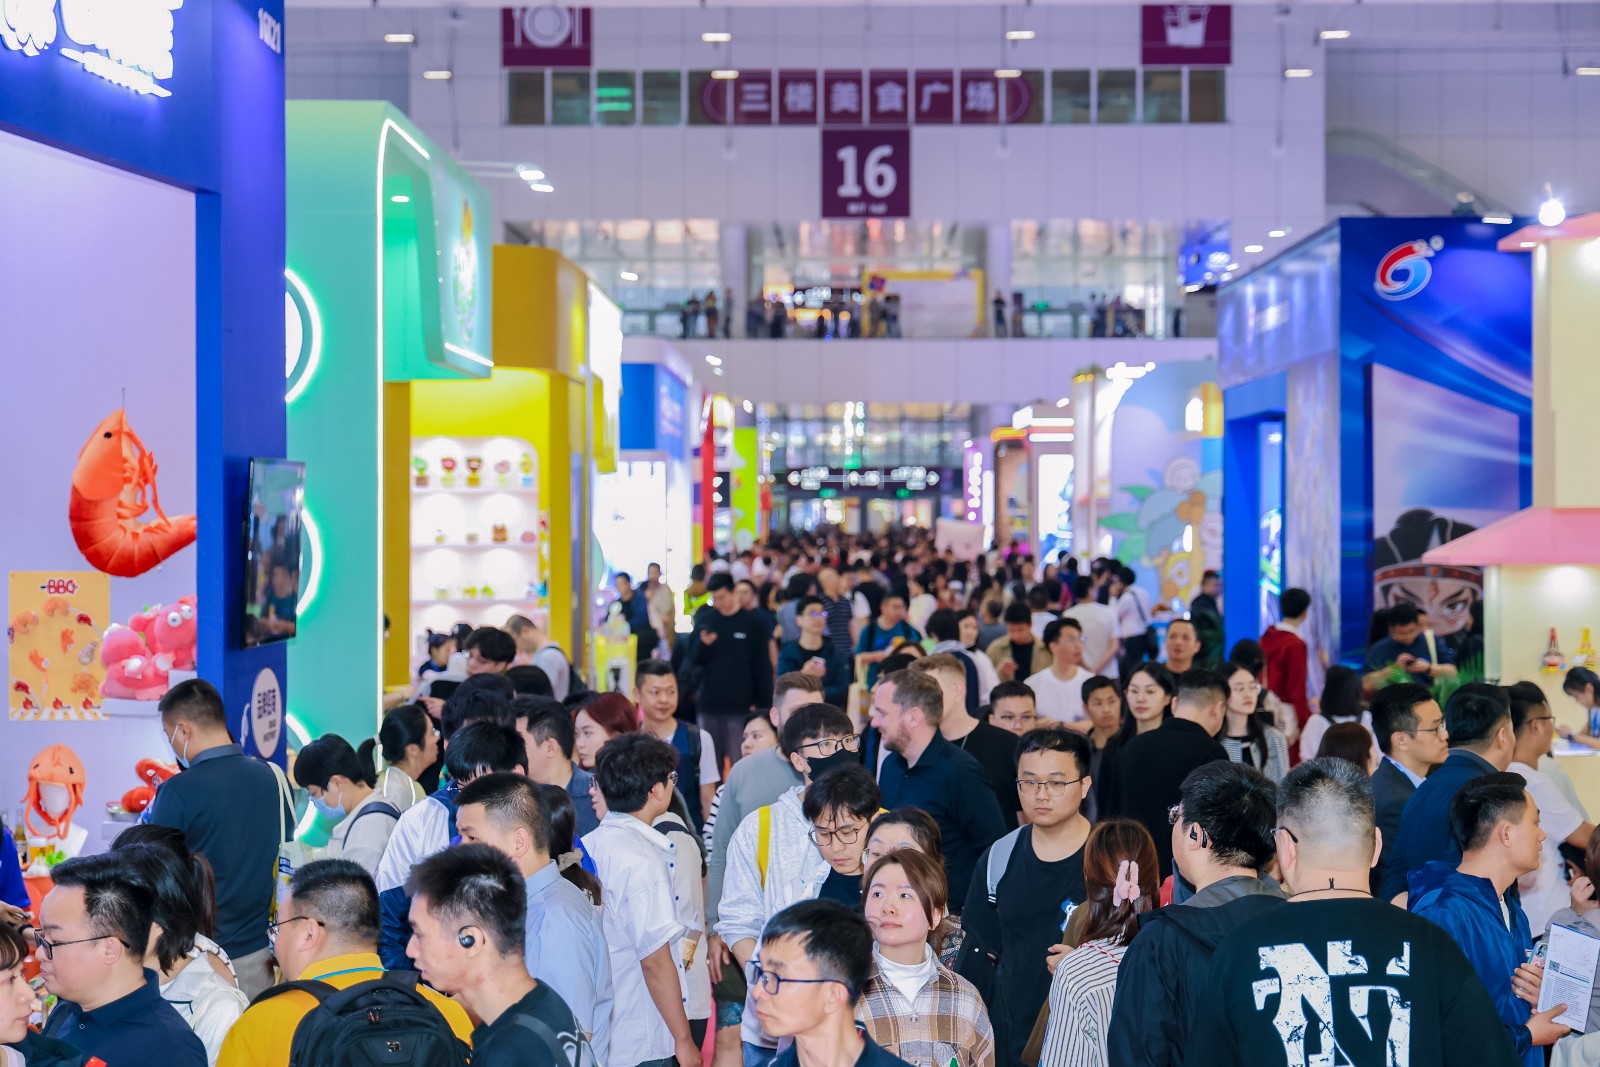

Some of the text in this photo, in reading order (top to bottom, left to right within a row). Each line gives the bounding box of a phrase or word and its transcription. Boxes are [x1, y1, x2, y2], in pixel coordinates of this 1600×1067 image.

[739, 80, 997, 114] 三楼美食广场
[836, 145, 898, 198] 16
[48, 579, 76, 594] BBQ
